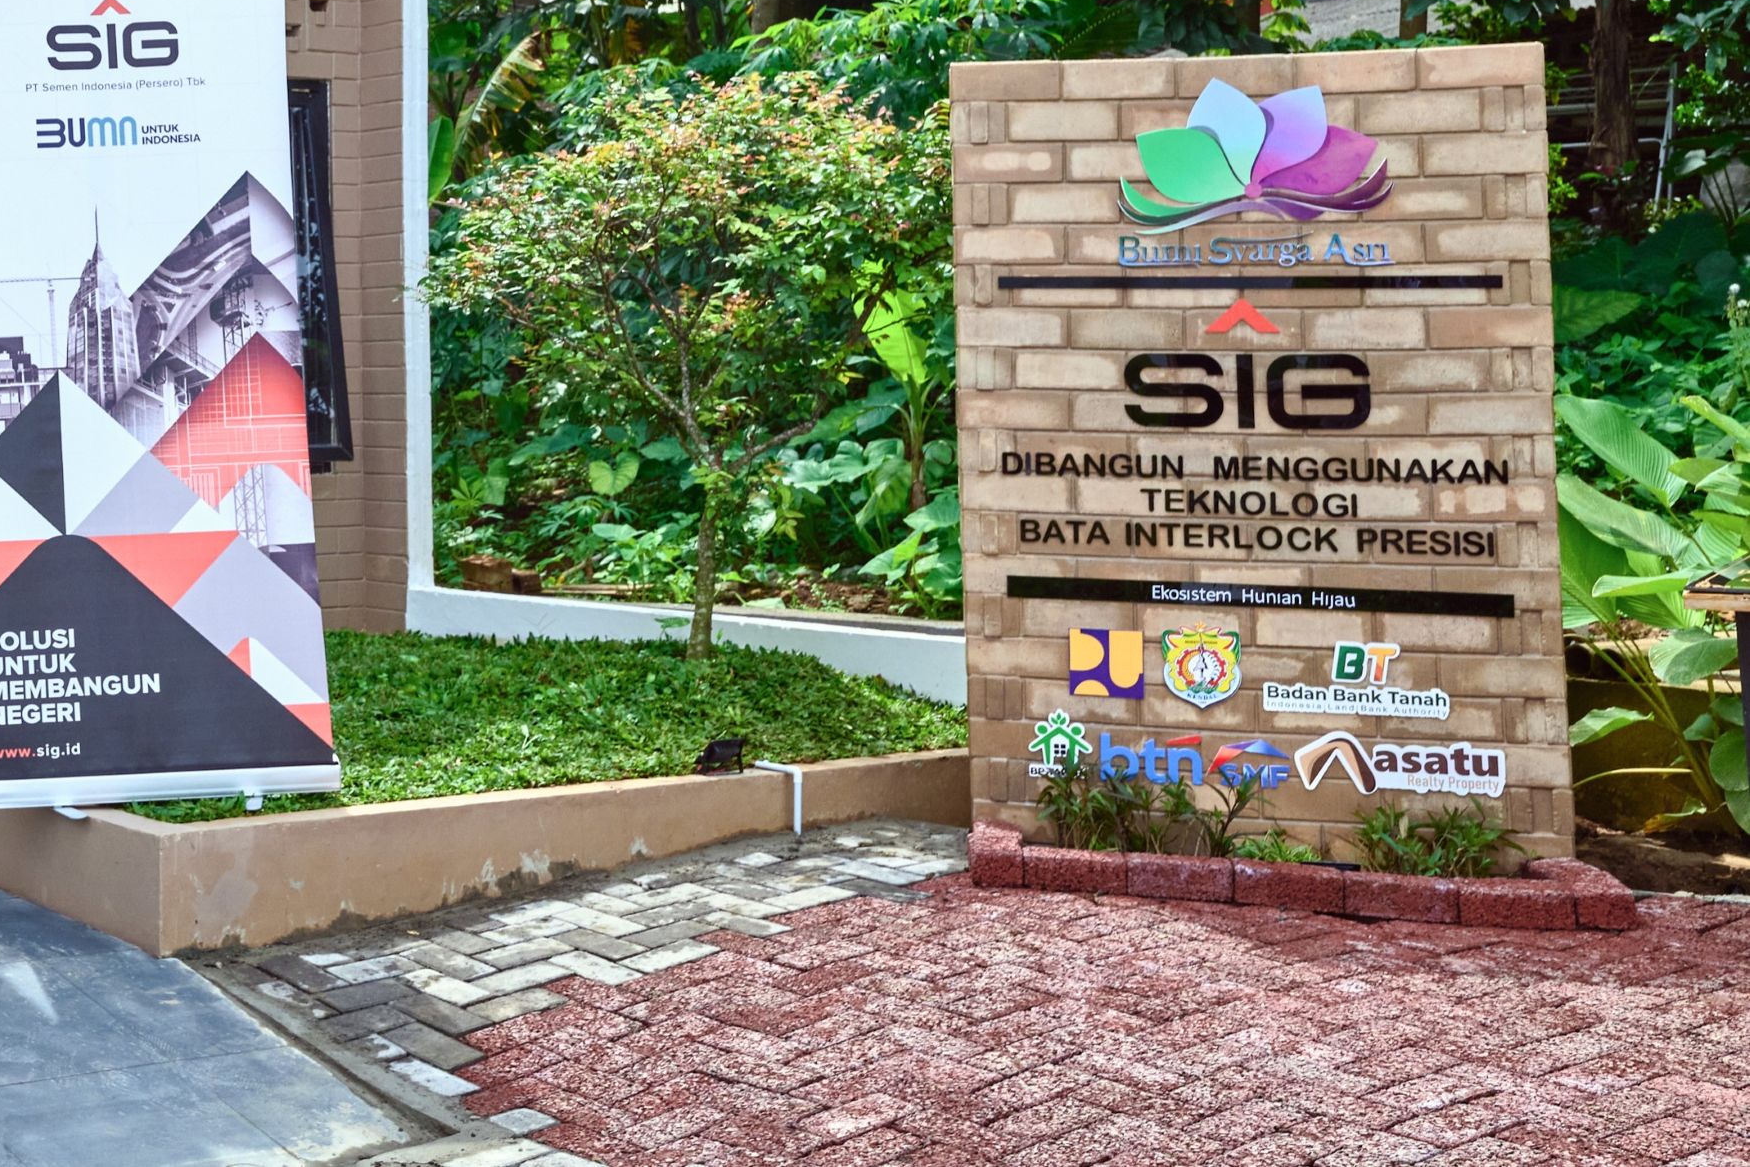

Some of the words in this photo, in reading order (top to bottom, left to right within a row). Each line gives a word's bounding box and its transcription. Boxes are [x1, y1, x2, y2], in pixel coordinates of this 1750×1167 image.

[46, 21, 179, 71] SIG
[25, 83, 39, 93] PT
[42, 82, 78, 92] Semen
[81, 80, 132, 91] Indonesia
[136, 78, 183, 90] (Persero)
[186, 77, 206, 87] Tbk
[141, 124, 179, 134] UNTUK
[141, 134, 201, 145] INDONESIA
[1118, 235, 1202, 267] Bumi
[1208, 232, 1315, 267] Svarga
[1323, 233, 1396, 266] Asri
[1123, 353, 1371, 430] SIG
[1001, 451, 1184, 479] DIBANGUN
[1213, 455, 1509, 485] MENGGUNAKAN
[1140, 488, 1358, 518] TEKNOLOGI
[1020, 519, 1110, 546] BATA
[1126, 522, 1338, 553] INTERLOCK
[1358, 527, 1495, 557] PRESISI
[1151, 585, 1232, 602] Ekosistem
[1242, 589, 1302, 605] Hunian
[1311, 591, 1356, 610] Hijau
[1335, 645, 1397, 681] BT
[1266, 701, 1322, 710] Indonesia
[1327, 704, 1355, 712] Land
[1393, 707, 1447, 717] Authority
[1267, 686, 1326, 701] Badan
[1333, 689, 1382, 704] Bank
[1388, 691, 1447, 707] Tanah
[1100, 732, 1203, 786] btn
[1220, 763, 1291, 789] SMF
[1407, 775, 1445, 788] Realty
[1449, 777, 1500, 792] Property
